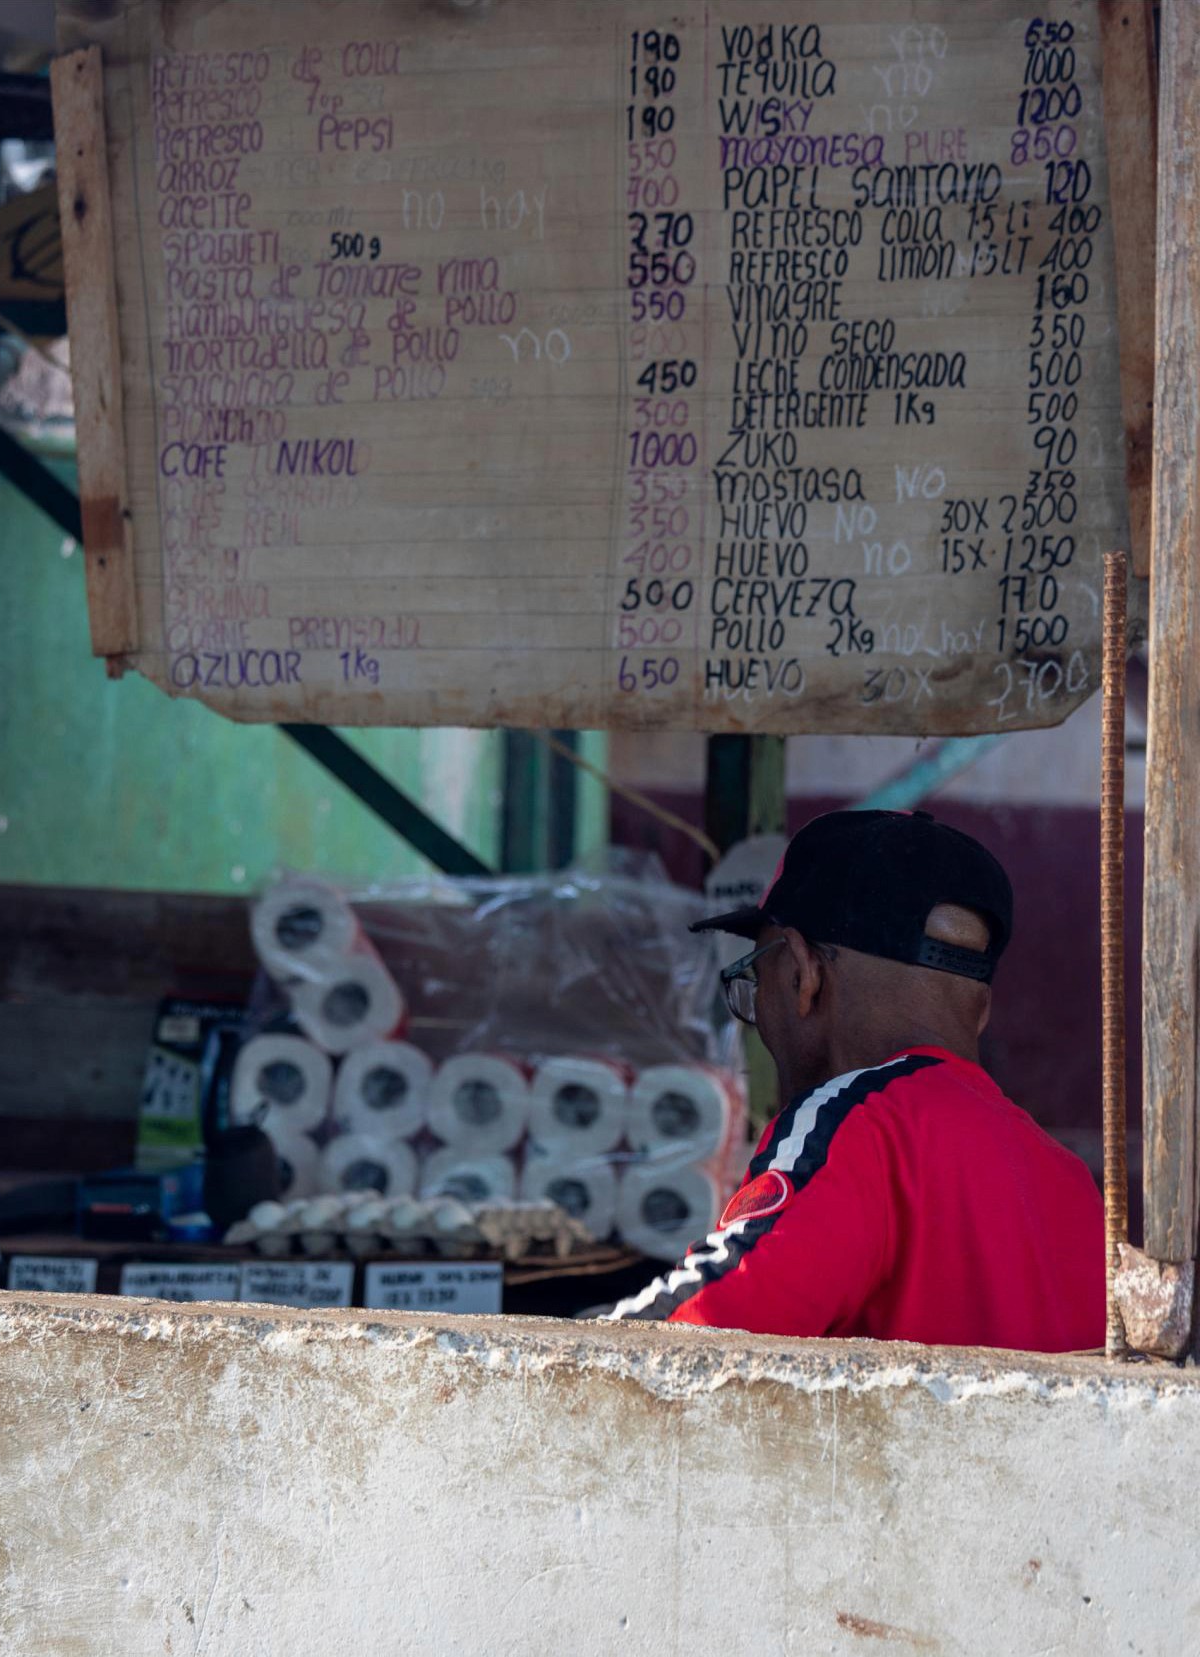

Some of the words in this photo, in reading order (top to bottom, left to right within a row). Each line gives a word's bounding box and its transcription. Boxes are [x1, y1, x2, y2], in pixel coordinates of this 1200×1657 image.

[631, 30, 680, 62] 190
[630, 65, 676, 98] 190
[1024, 46, 1076, 85] 1000
[626, 104, 675, 141] 190
[718, 96, 814, 137] WISKY
[1017, 82, 1083, 127] 1200
[627, 138, 677, 173] 550
[1011, 124, 1076, 167] 850
[1048, 205, 1102, 236] 400
[1038, 237, 1093, 273] 400
[631, 290, 685, 322] 550
[1029, 312, 1085, 350] 350
[637, 359, 697, 394] 450
[1028, 350, 1083, 389] 500
[1027, 392, 1080, 425] 500
[629, 430, 698, 469] 1000
[715, 429, 798, 469] ZUKO
[1032, 425, 1078, 470] 90
[719, 500, 808, 540] HUEVO
[999, 491, 1078, 534] 2500
[714, 541, 809, 578] HUEVO
[1003, 534, 1076, 575] 1250
[710, 617, 786, 652] POLLO
[618, 654, 680, 694] 650
